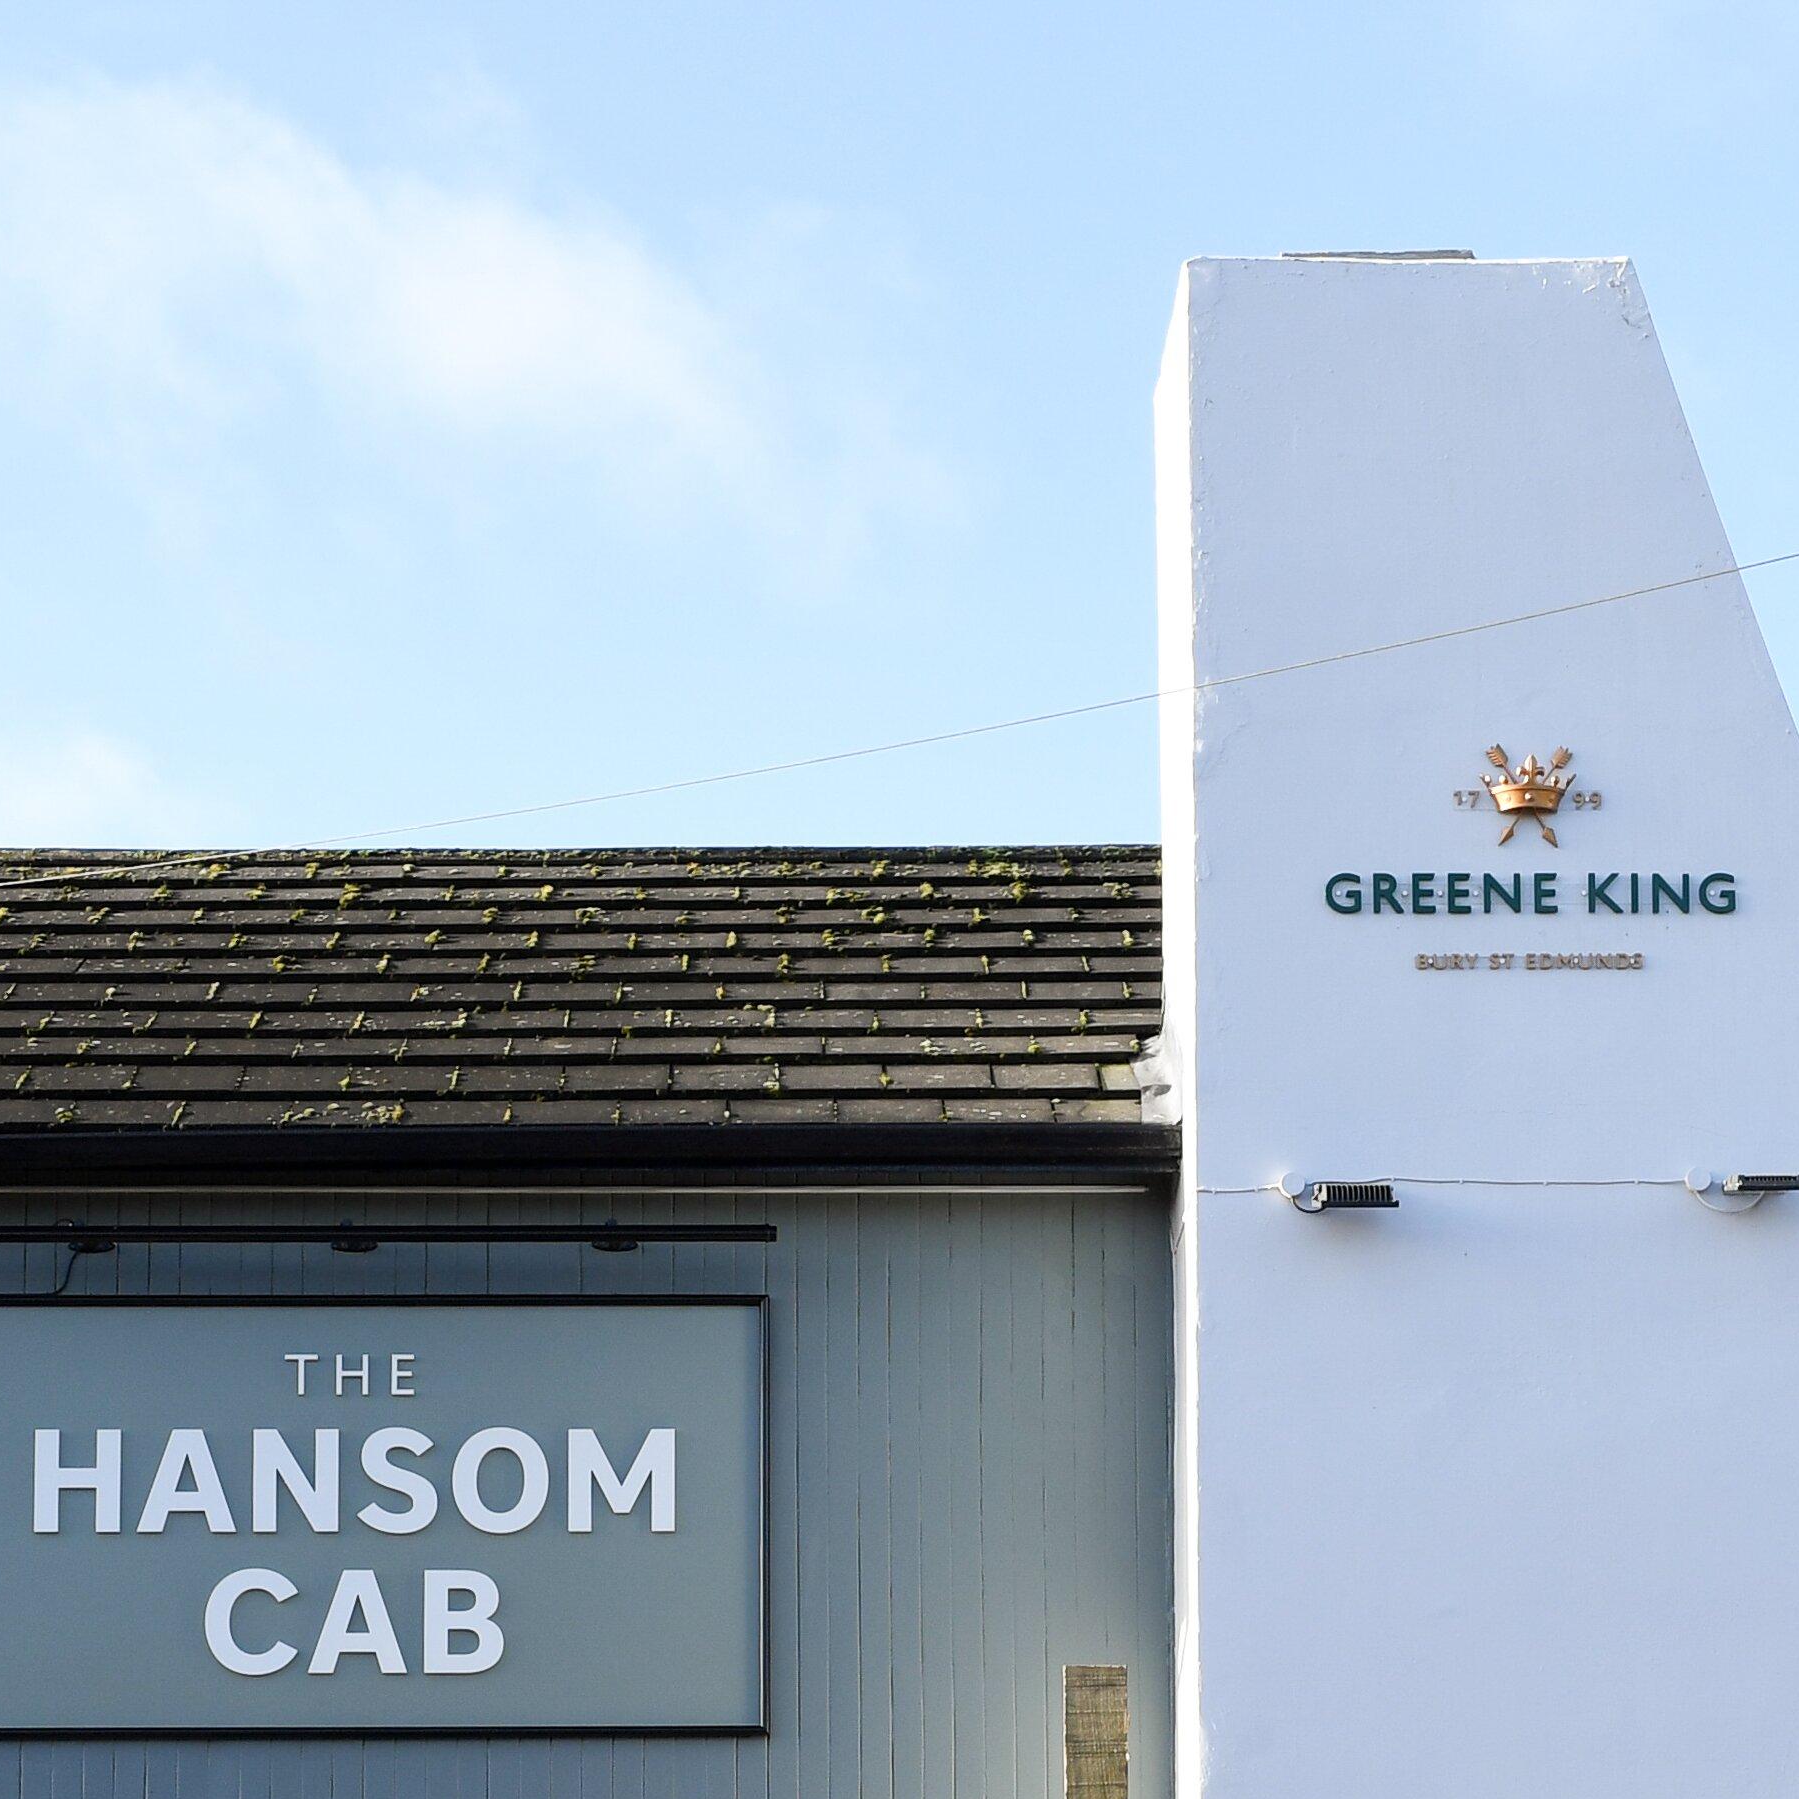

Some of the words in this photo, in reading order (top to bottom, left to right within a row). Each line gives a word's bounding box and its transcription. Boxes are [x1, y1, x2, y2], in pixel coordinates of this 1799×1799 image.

[1452, 790, 1480, 809] 17
[1572, 790, 1602, 809] 99
[1325, 872, 1559, 915] GREENE
[1587, 872, 1737, 915] KING
[1414, 953, 1479, 971] BURY
[1489, 953, 1515, 971] ST
[1525, 953, 1644, 971] EDMUNDS
[284, 1353, 418, 1397] THE
[32, 1426, 677, 1535] HANSOM
[204, 1567, 505, 1676] CAB
